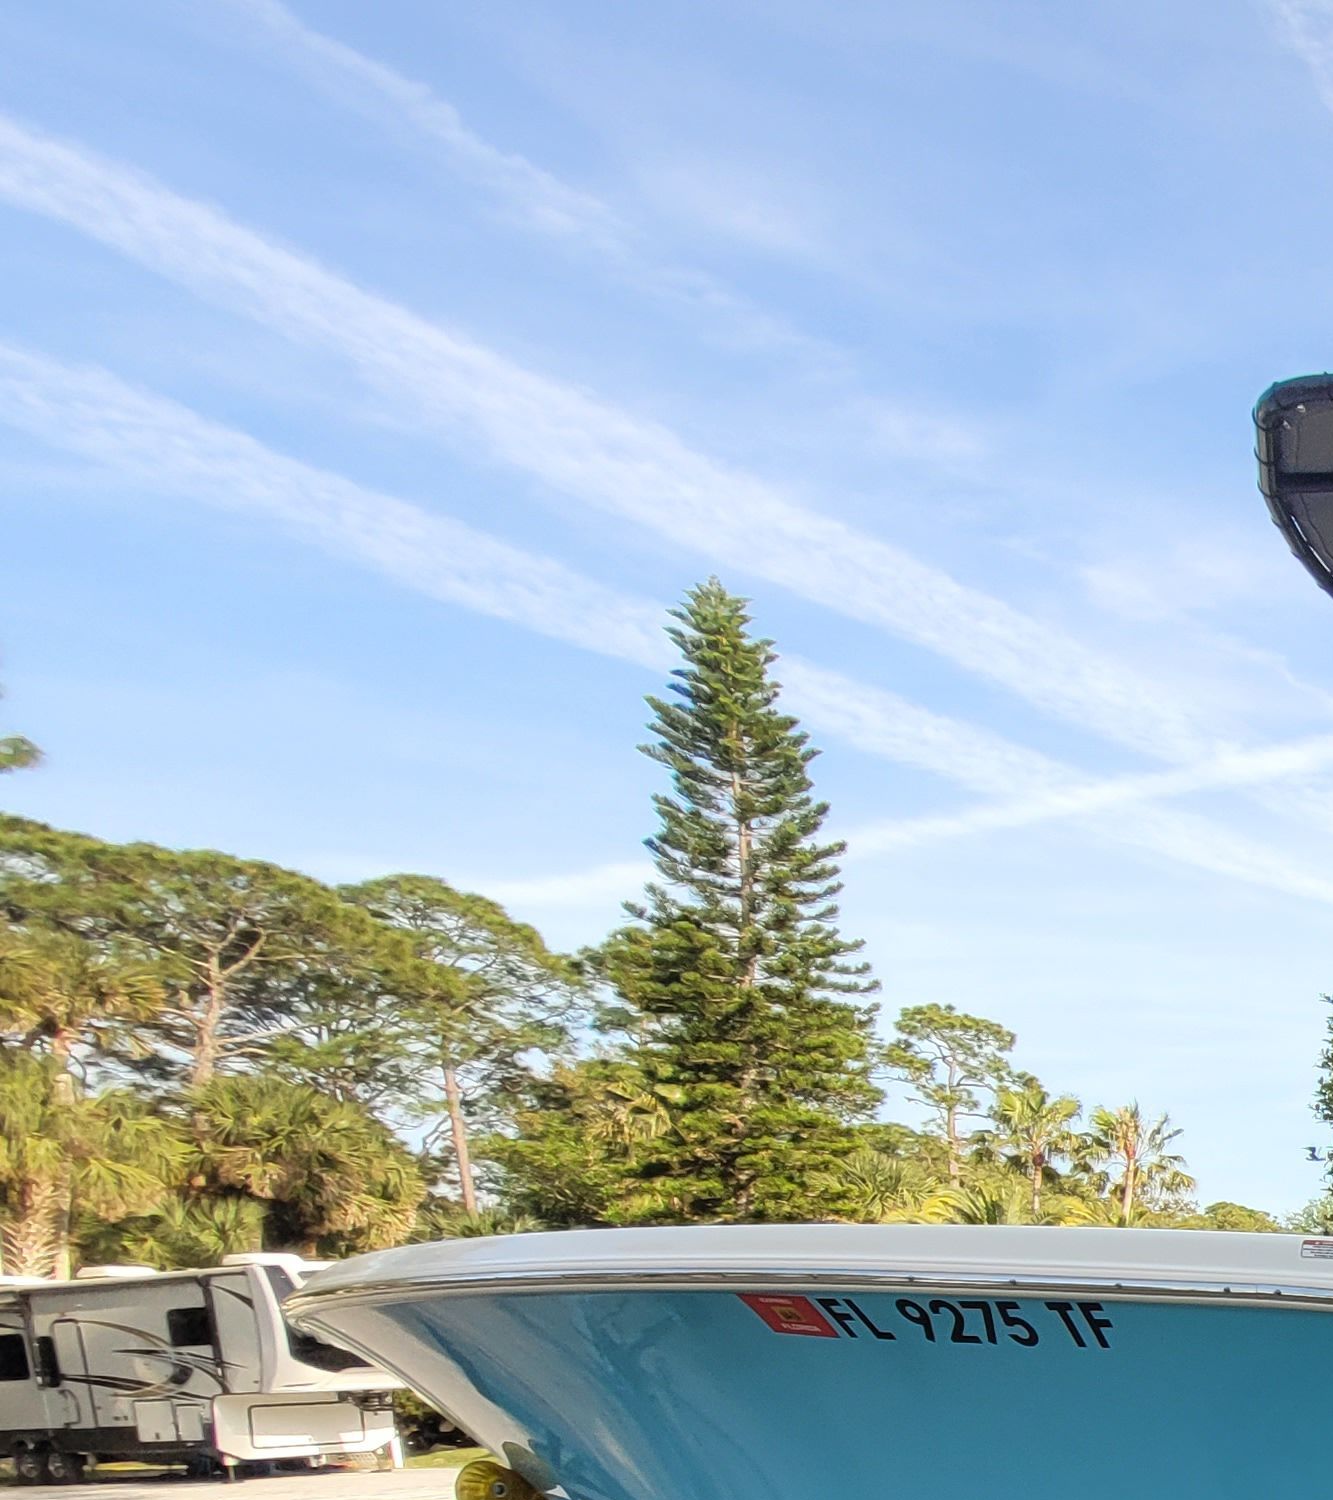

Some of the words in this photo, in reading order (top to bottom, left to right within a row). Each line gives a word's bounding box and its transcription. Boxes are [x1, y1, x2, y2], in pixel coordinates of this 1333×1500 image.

[815, 1298, 896, 1340] FL
[895, 1298, 1040, 1347] 9275
[1044, 1301, 1114, 1348] TF
